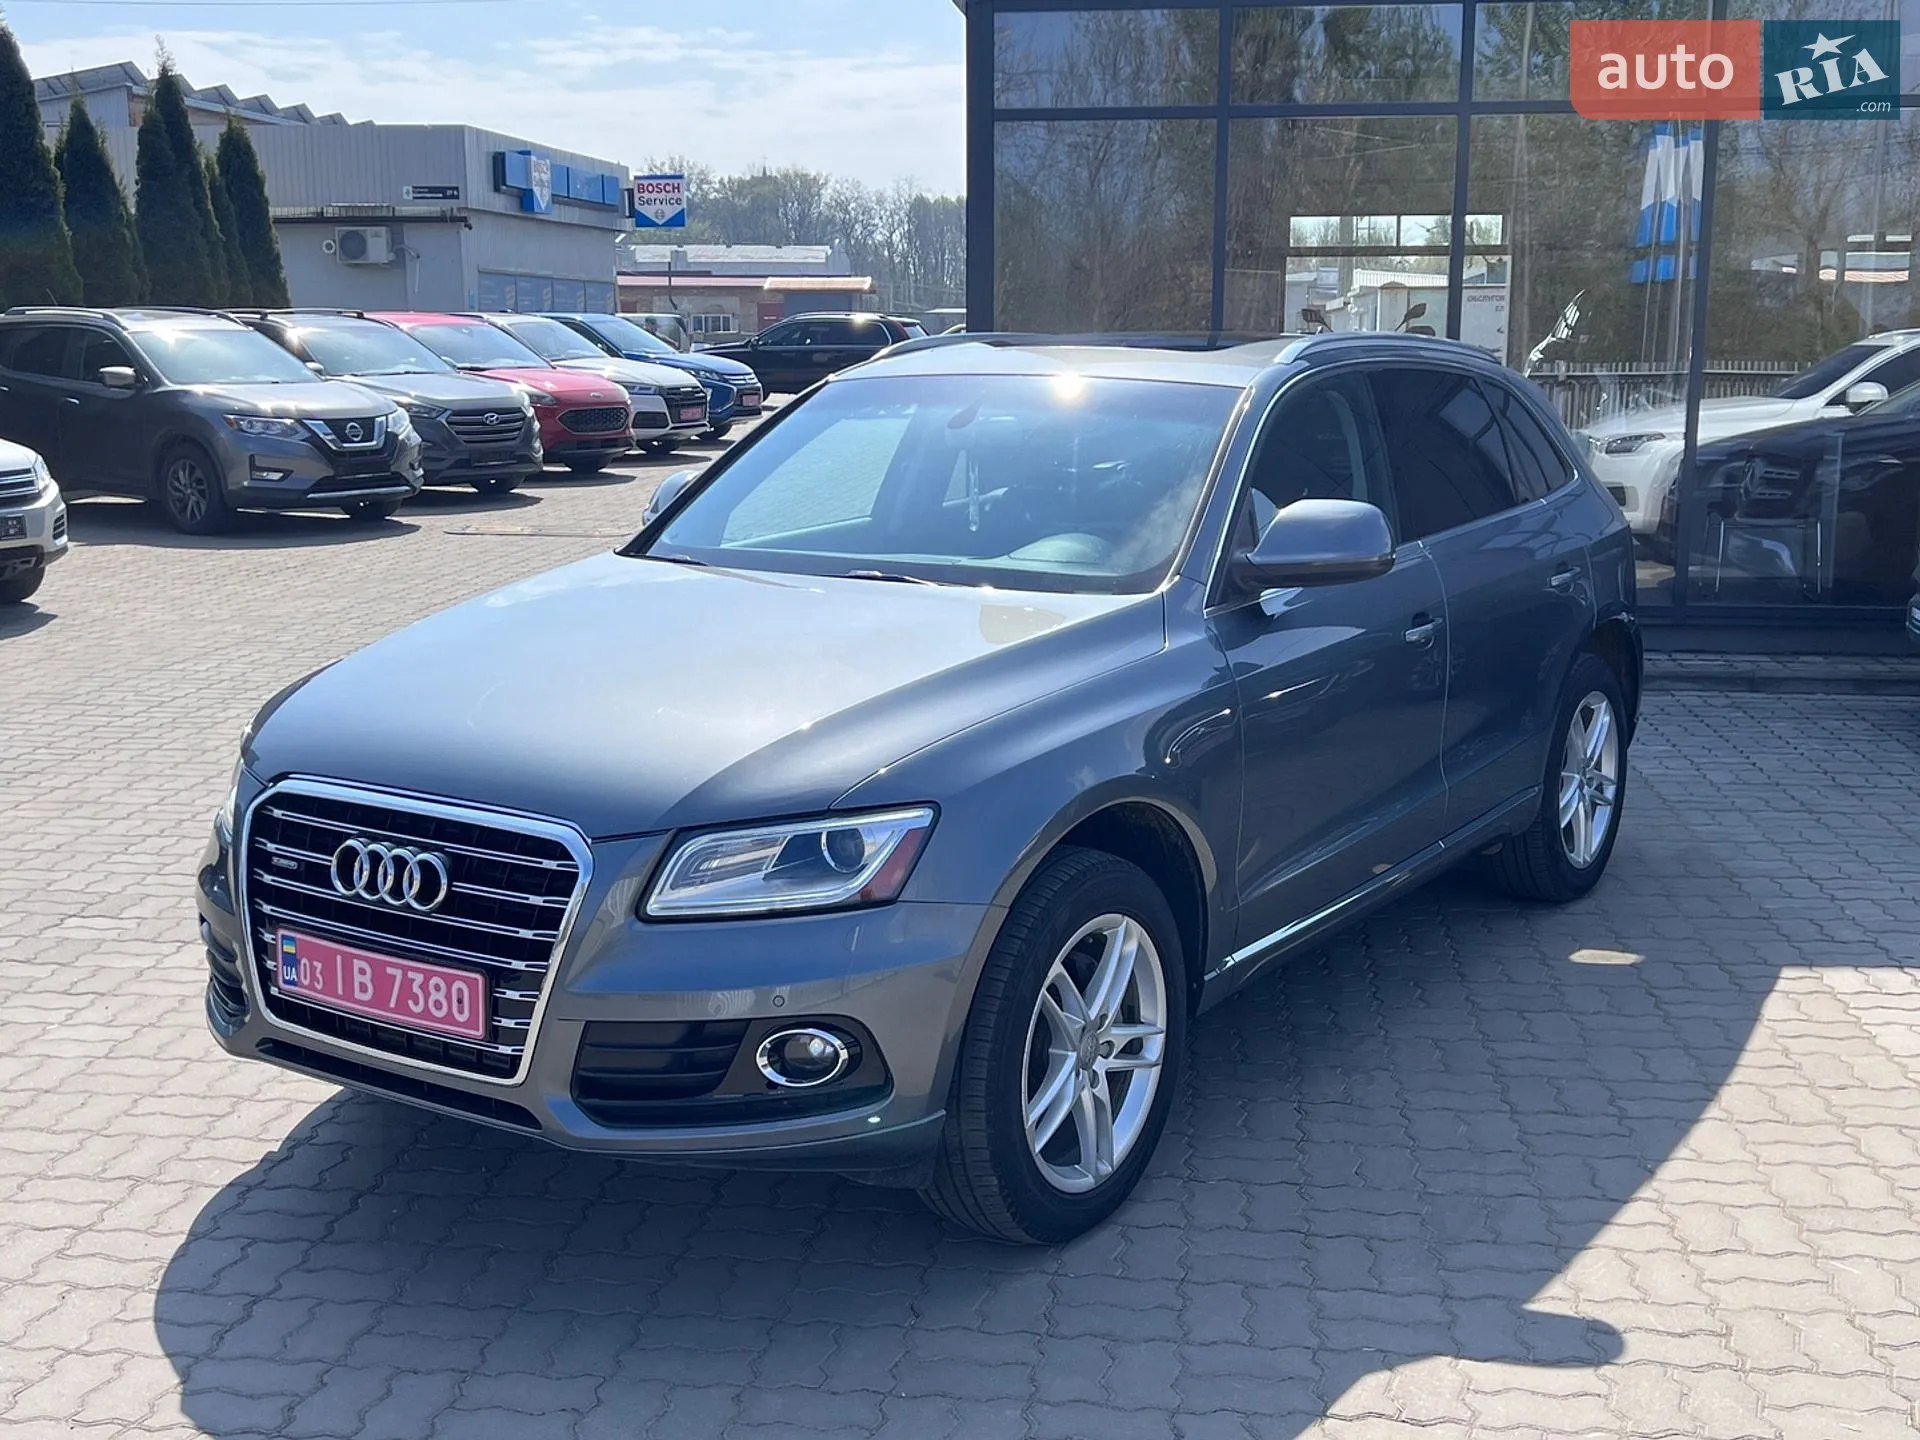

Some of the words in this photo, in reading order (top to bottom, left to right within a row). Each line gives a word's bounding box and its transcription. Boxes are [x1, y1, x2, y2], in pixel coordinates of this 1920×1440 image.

[637, 183, 681, 194] BOSCH
[638, 195, 682, 206] Service
[283, 966, 298, 981] UA
[301, 957, 324, 990] 03
[385, 966, 471, 1023] 7380
